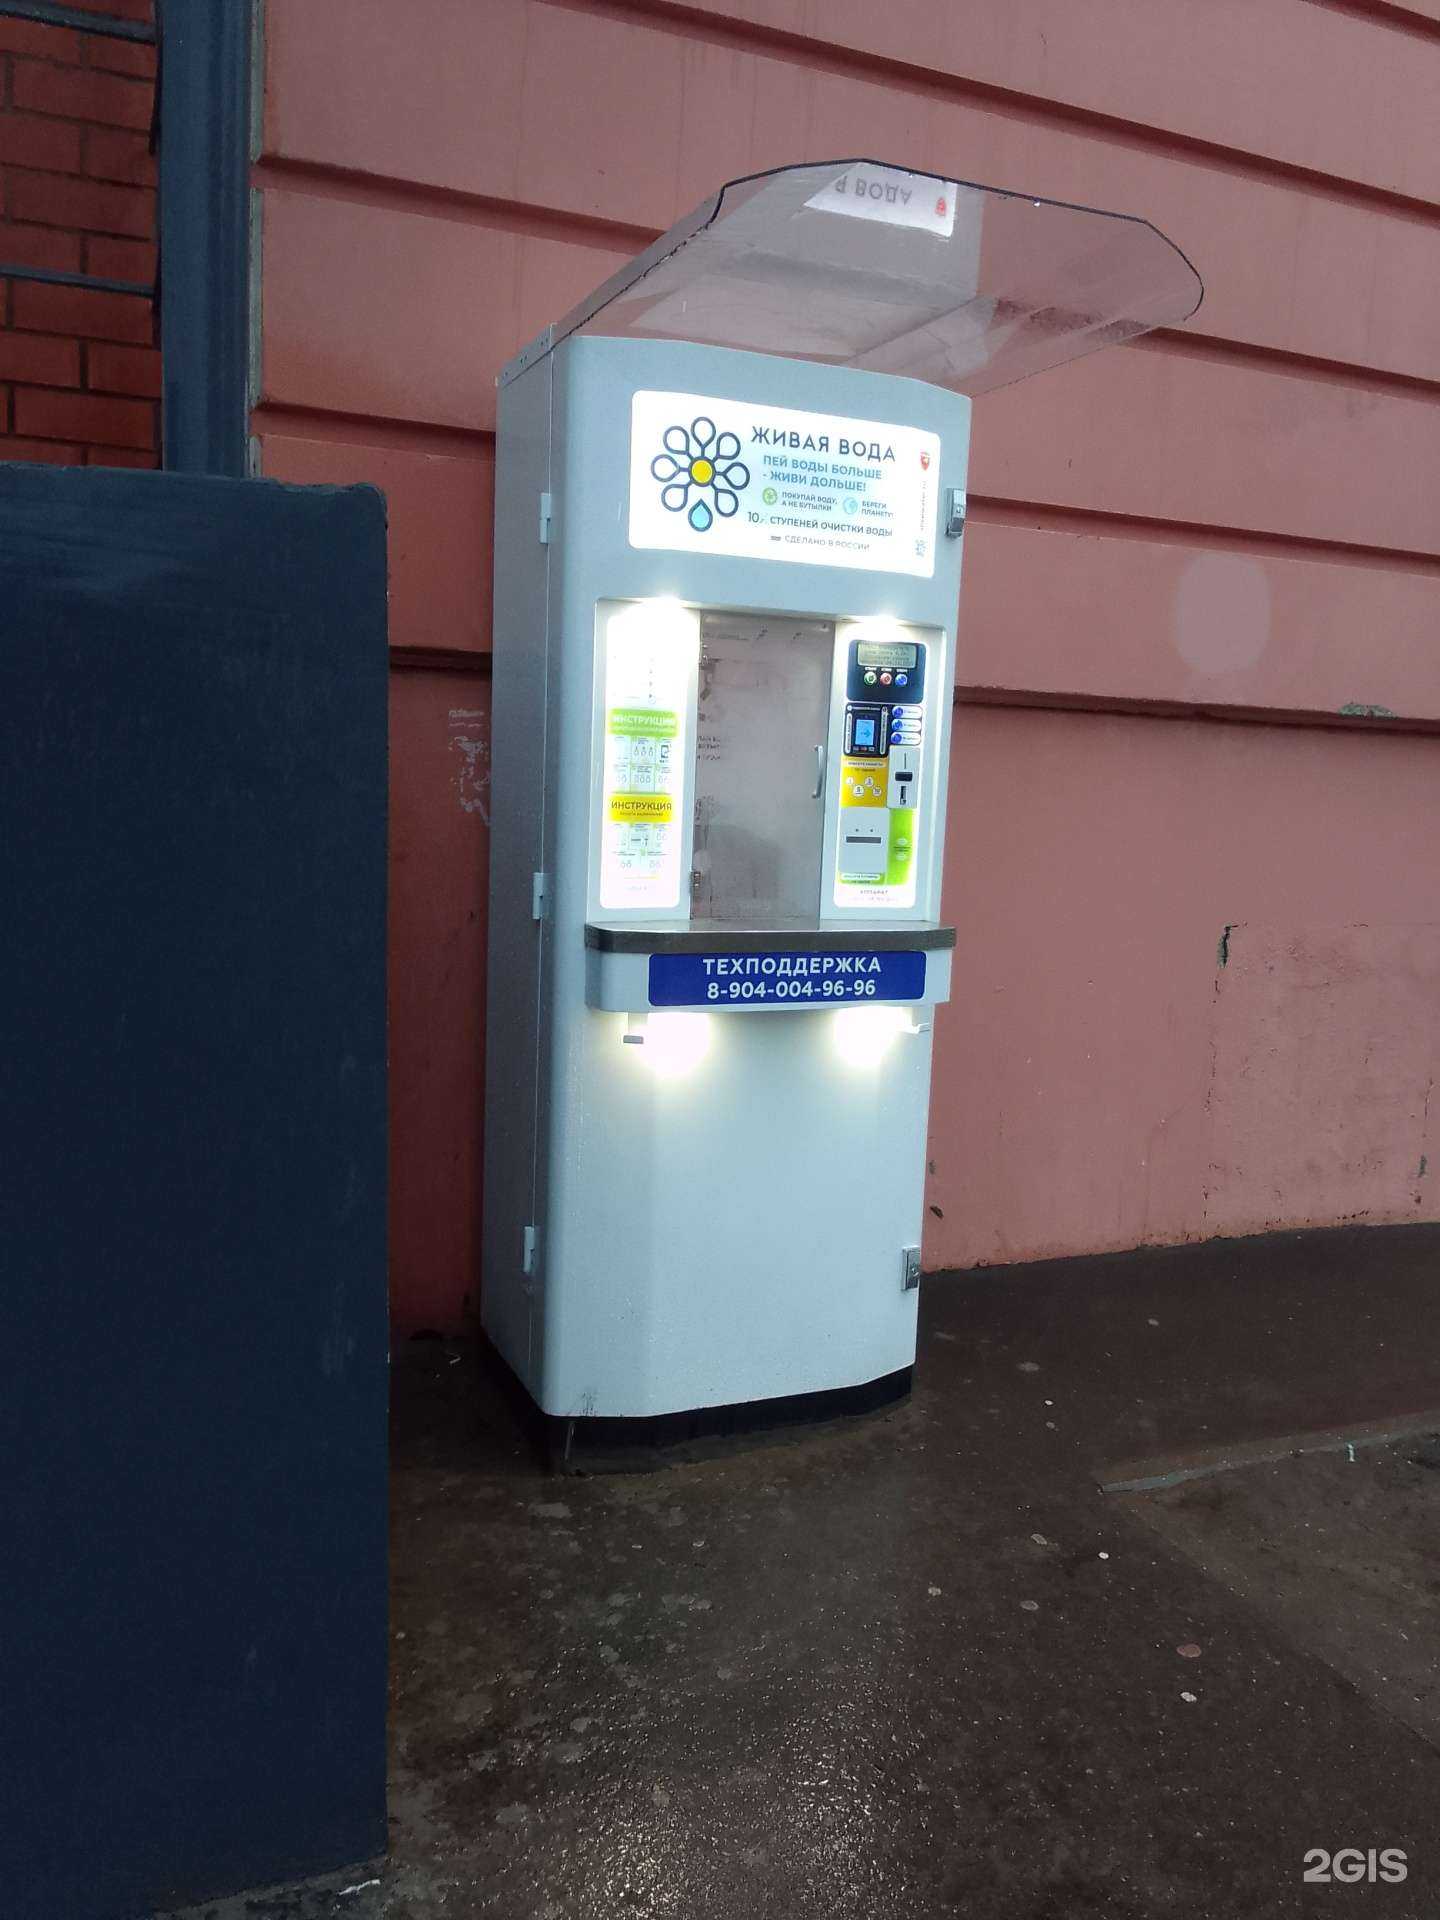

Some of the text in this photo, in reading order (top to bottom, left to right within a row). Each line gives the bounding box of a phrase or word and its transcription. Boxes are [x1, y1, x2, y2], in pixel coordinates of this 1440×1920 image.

[751, 426, 896, 462] ЖИВАЯ ВОДА
[763, 455, 883, 480] ПЕЙ ВОДЫ БОЛЬШЕ
[770, 471, 807, 485] ЖИВИ
[810, 477, 867, 492] ДОЛЬШЕ!
[782, 491, 838, 505] ПОКУПАЙ ВОДУ,
[799, 503, 832, 512] БУТЫЛКИ
[770, 516, 818, 529] СТУПЕНЕЙ
[820, 521, 864, 534] ОЧИСТКИ
[866, 526, 893, 537] ВОДЫ
[785, 535, 826, 546] СДЕЛАНО
[835, 541, 870, 550] РОССИИ
[611, 801, 672, 811] ИНСТРУКЦИЯ
[702, 956, 882, 977] ТЕХПОДДЕРЖКА
[707, 979, 876, 999] 8-904-004-96-96
